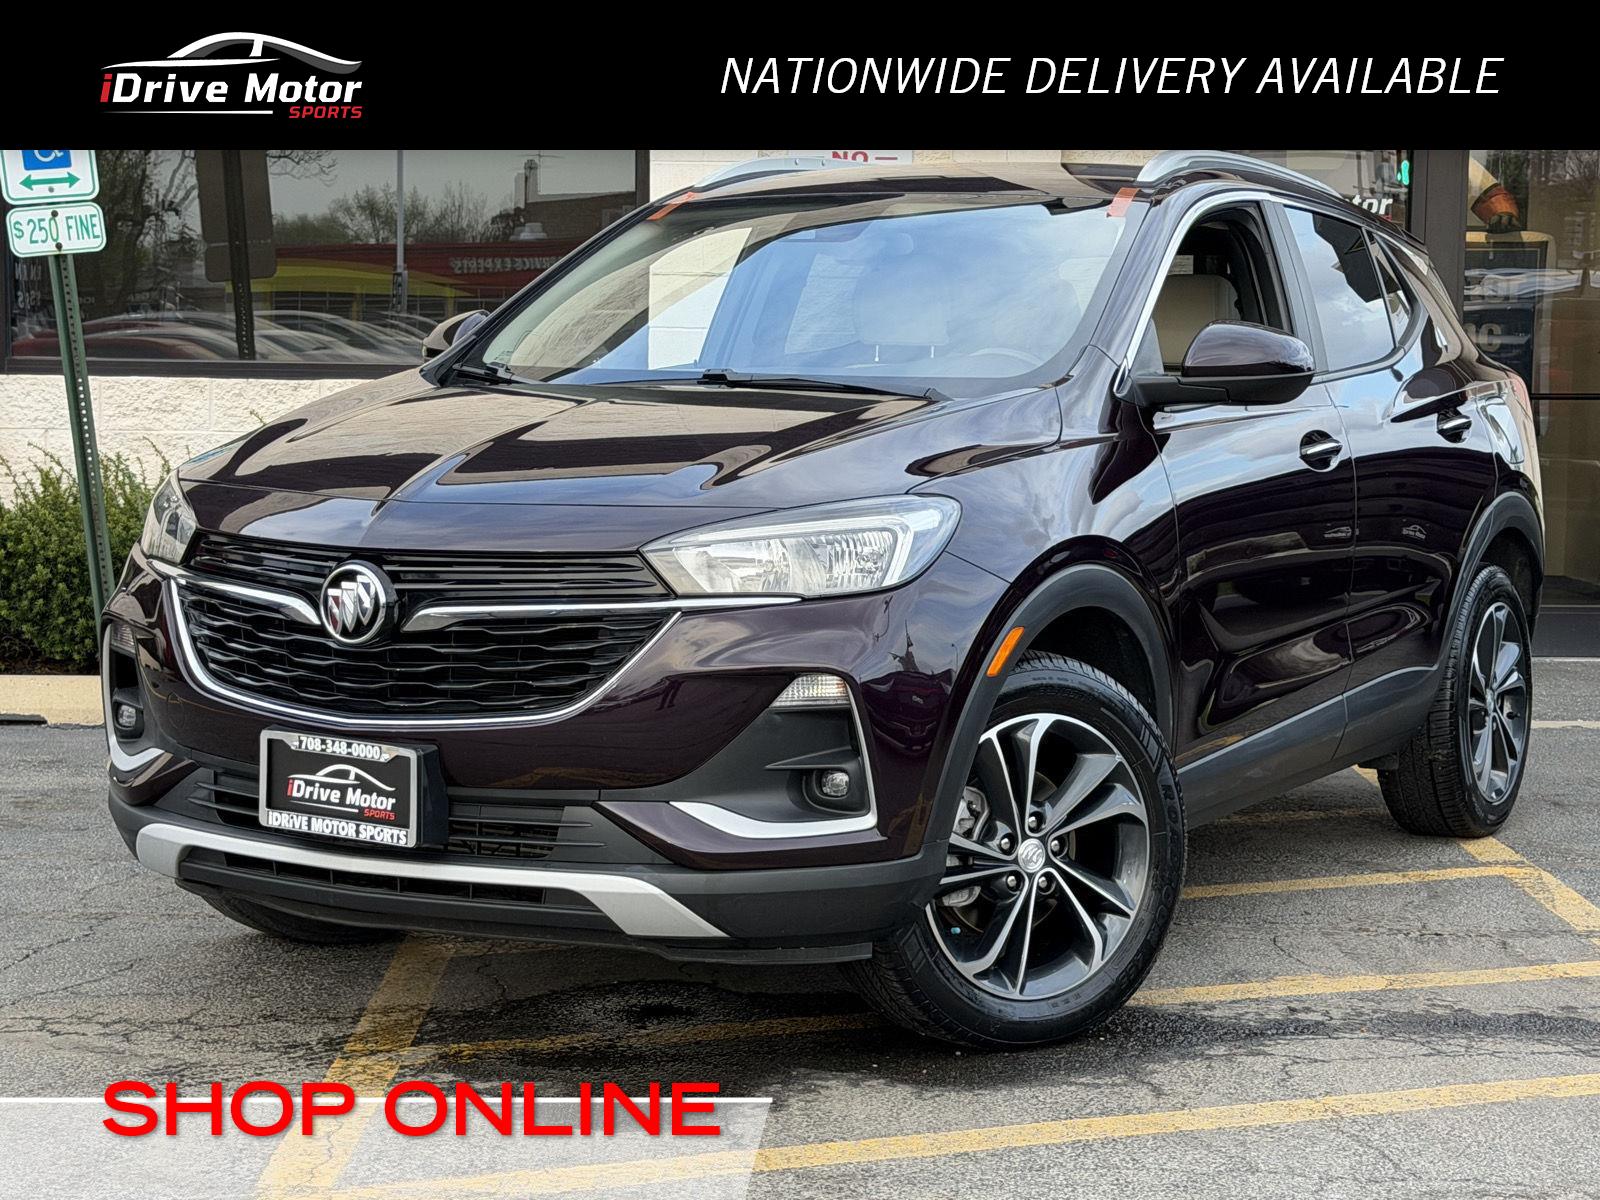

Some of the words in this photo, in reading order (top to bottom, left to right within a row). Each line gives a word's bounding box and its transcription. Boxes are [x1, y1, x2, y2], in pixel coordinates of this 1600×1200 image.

[65, 213, 101, 242] FINE
[300, 736, 381, 759] 708-348-0000
[287, 778, 341, 803] iDrive
[345, 787, 396, 811] Motor
[363, 808, 396, 820] SPORTS
[311, 817, 357, 838] MOTOR
[359, 824, 407, 845] SPORTS
